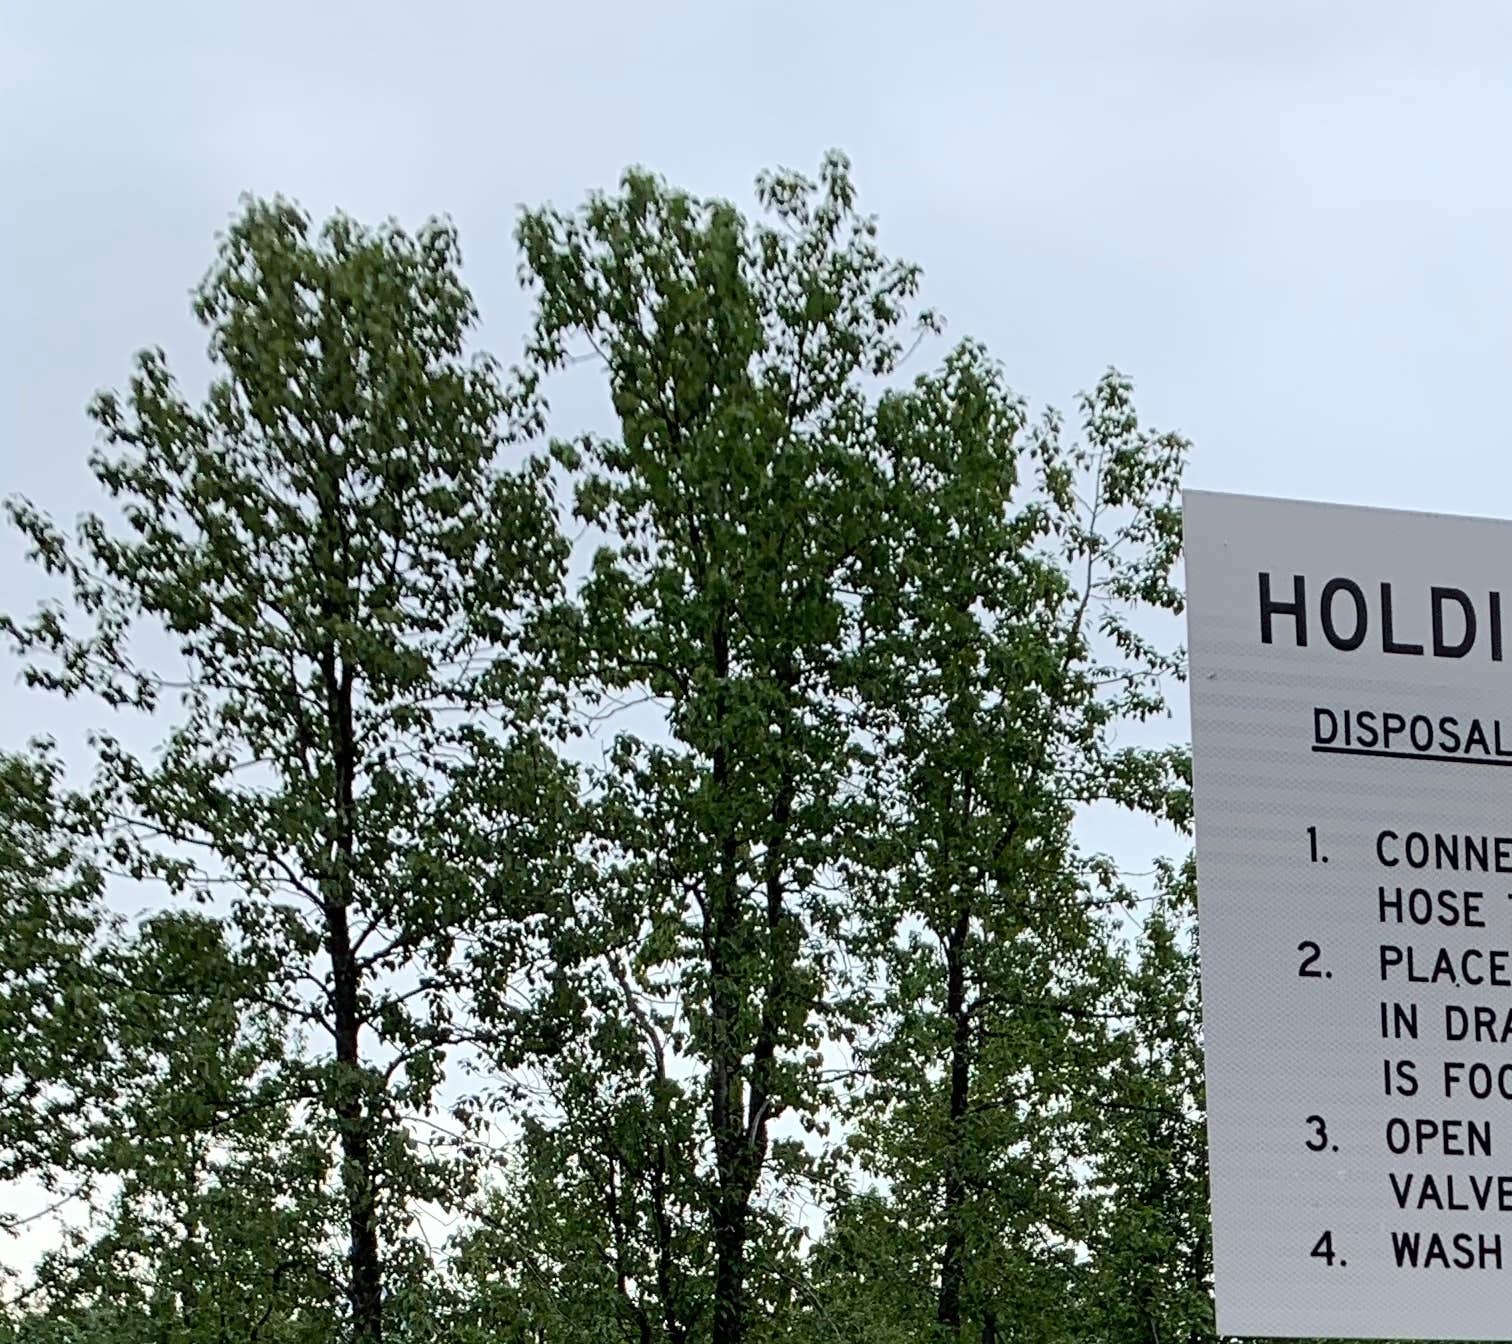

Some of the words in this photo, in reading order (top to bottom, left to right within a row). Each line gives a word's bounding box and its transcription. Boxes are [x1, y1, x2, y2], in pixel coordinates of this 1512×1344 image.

[1306, 827, 1330, 865] 1.
[1378, 887, 1486, 928] HOSE
[1298, 942, 1334, 980] 2.
[1379, 946, 1510, 989] PLACE
[1380, 1003, 1418, 1040] IN
[1383, 1060, 1418, 1097] IS
[1305, 1117, 1340, 1152] 3.
[1387, 1119, 1492, 1158] OPEN
[1310, 1231, 1347, 1268] 4.
[1391, 1234, 1503, 1269] WASH
